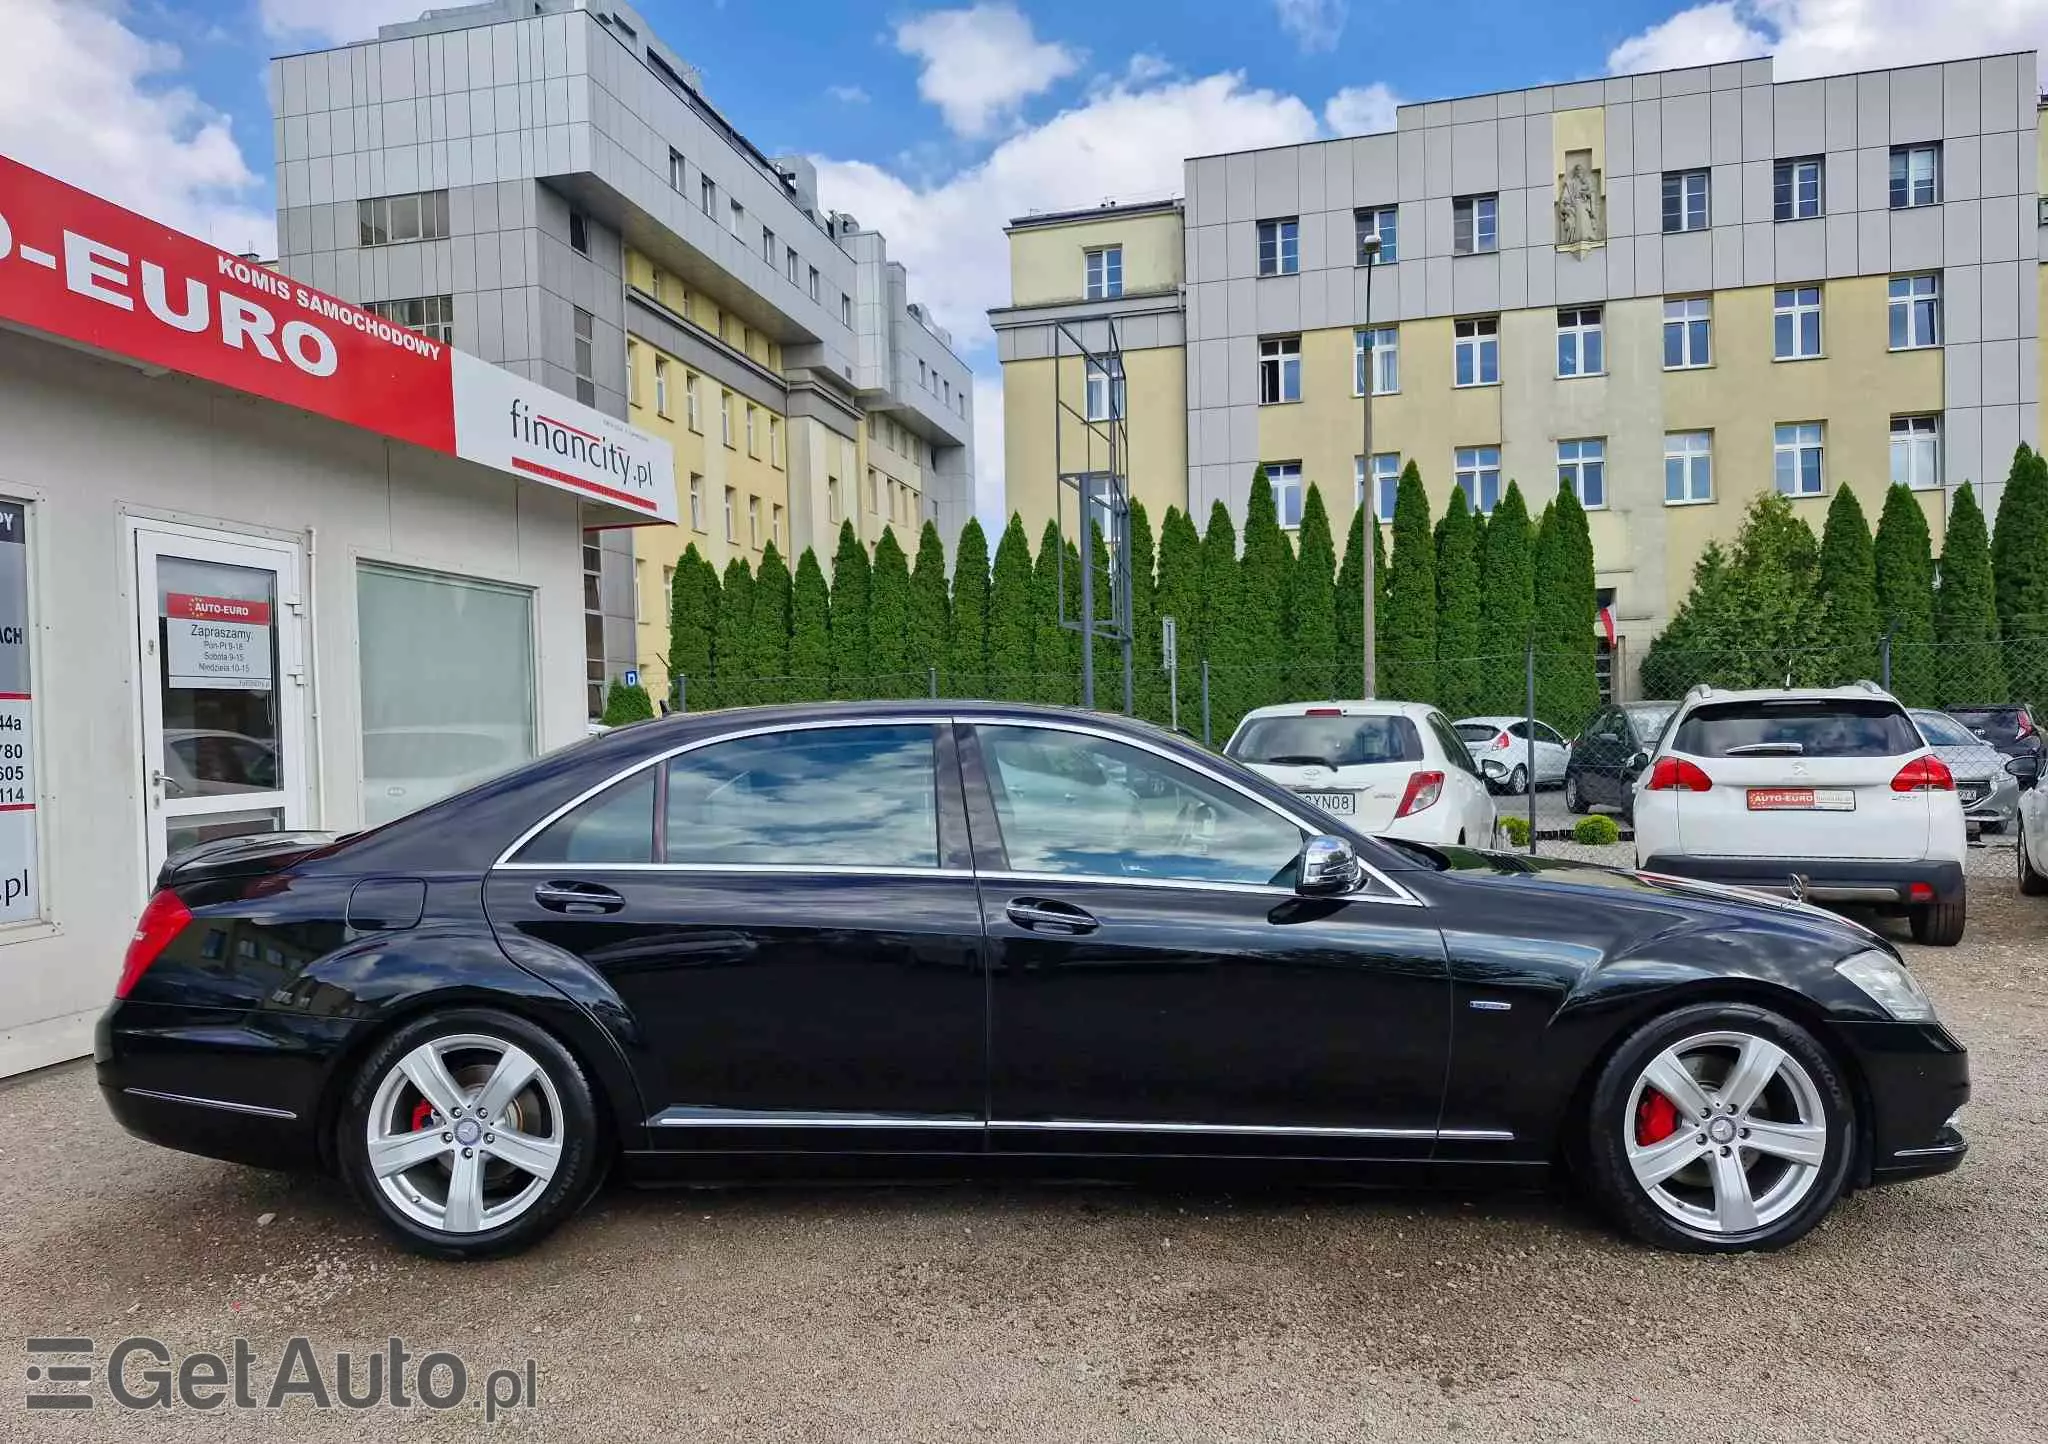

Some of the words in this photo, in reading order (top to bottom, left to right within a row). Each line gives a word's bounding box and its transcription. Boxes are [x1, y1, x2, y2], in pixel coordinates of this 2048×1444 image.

[0, 213, 338, 377] -EURO
[218, 255, 290, 300] KOMIS
[297, 287, 441, 361] SAMOCHODOWY
[510, 398, 653, 489] financity.pl
[195, 603, 249, 616] AUTO-EURO
[1755, 794, 1813, 802] AUTO-EURO
